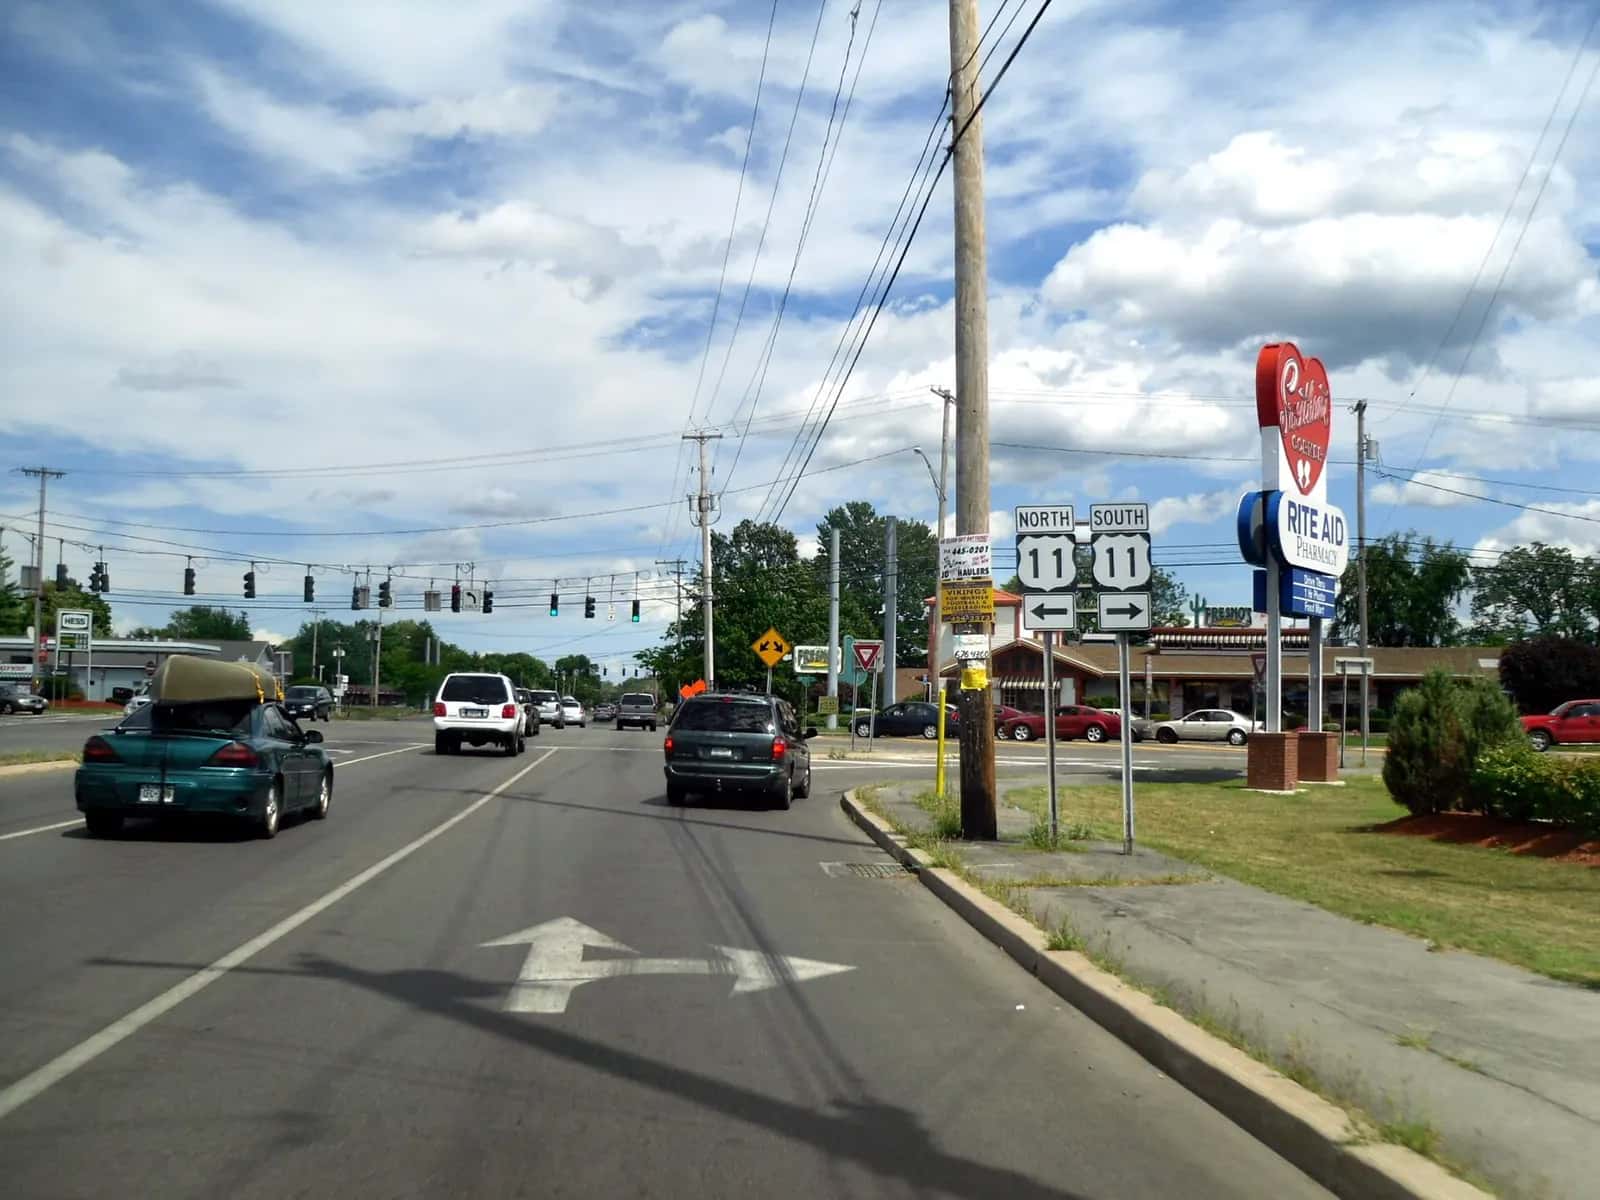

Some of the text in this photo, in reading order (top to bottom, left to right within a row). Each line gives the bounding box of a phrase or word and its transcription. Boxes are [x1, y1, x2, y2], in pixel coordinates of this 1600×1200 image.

[1019, 511, 1070, 527] NORTH
[1094, 509, 1144, 526] SOUTH
[1288, 501, 1344, 546] RITE AID
[1106, 547, 1136, 578] 11
[1296, 536, 1337, 566] PHARMACY
[1028, 548, 1062, 579] 11
[946, 588, 987, 596] VIKINGS
[65, 616, 86, 625] HESS
